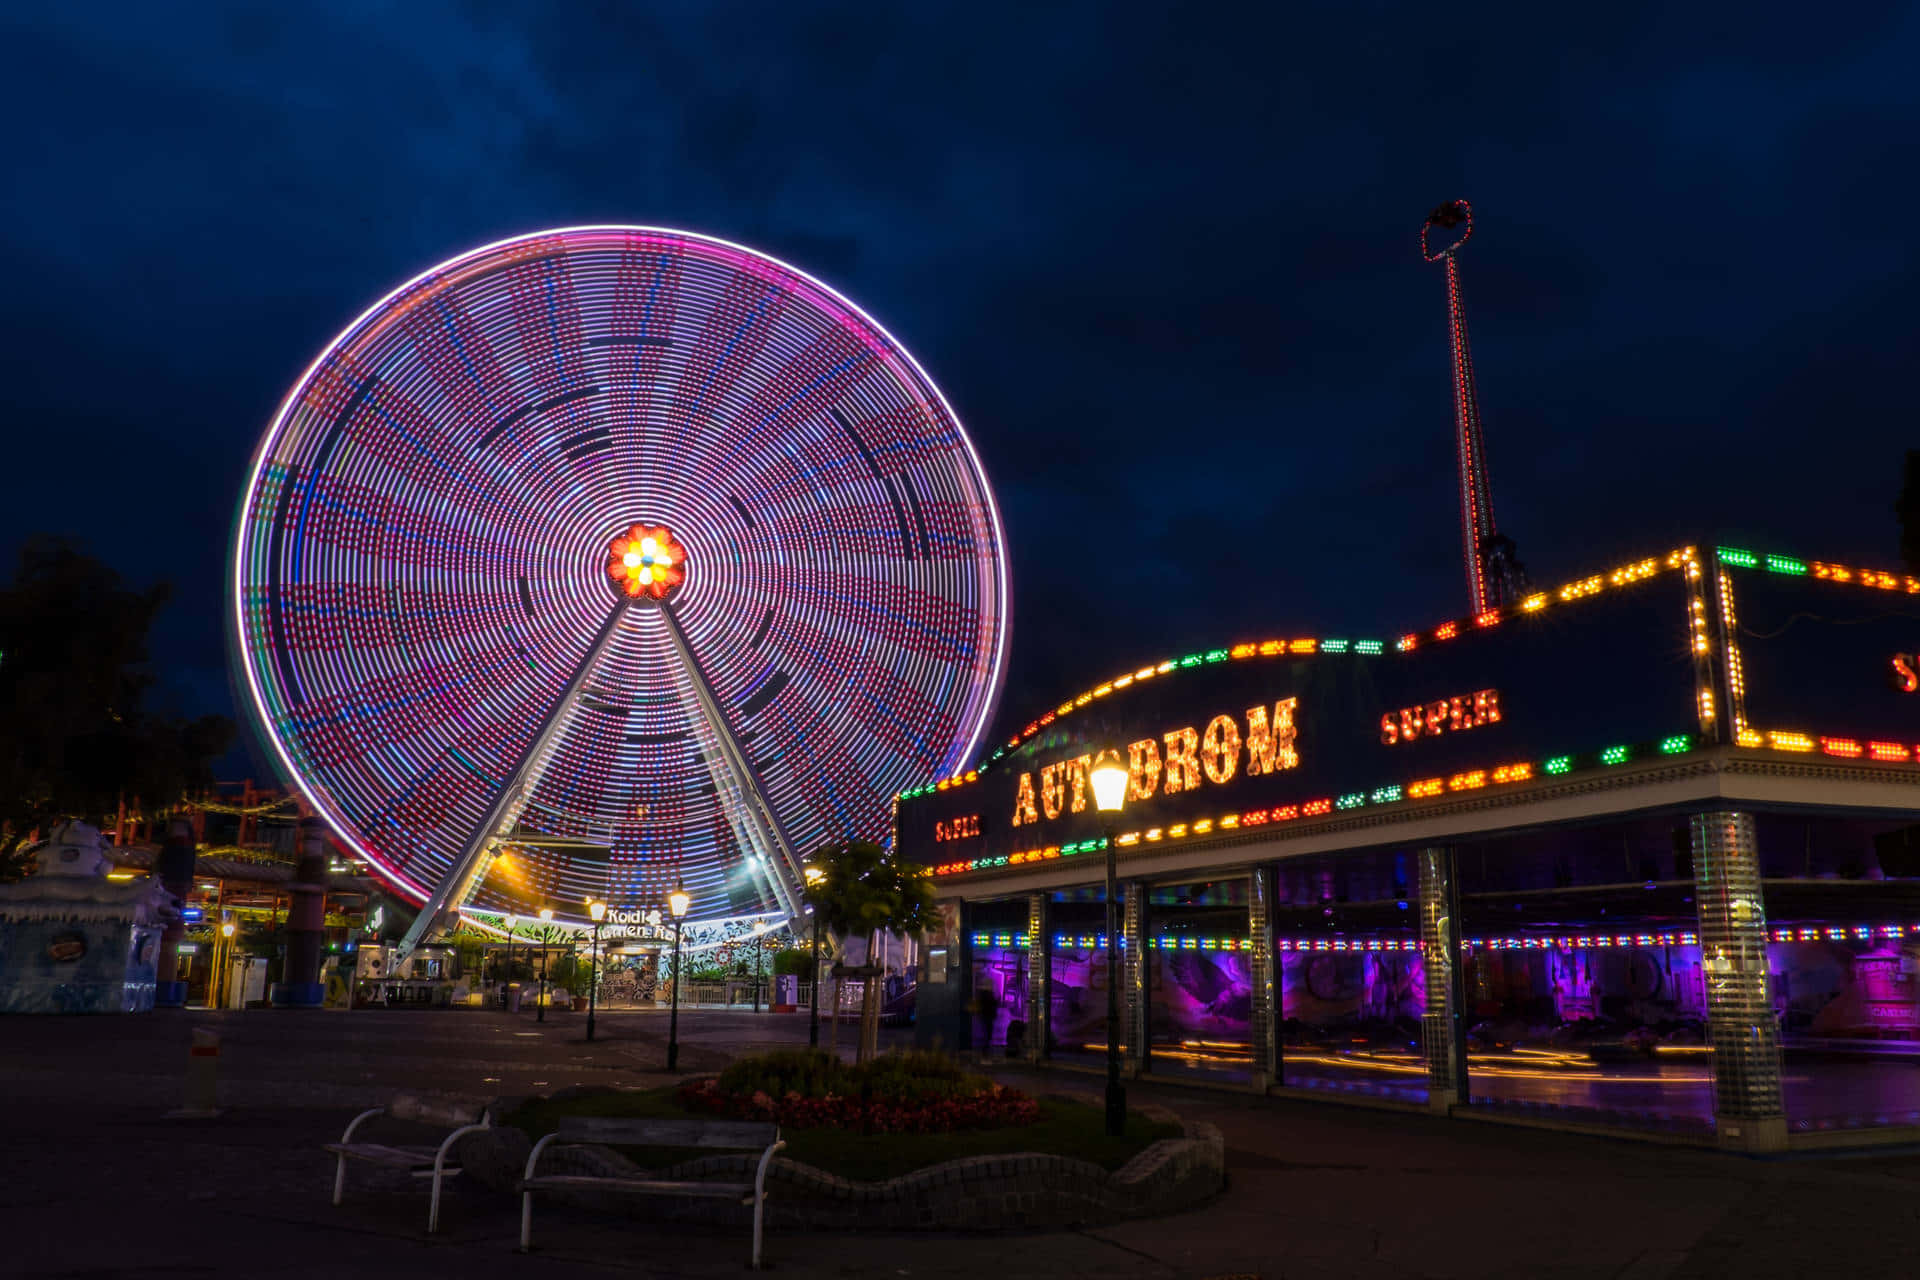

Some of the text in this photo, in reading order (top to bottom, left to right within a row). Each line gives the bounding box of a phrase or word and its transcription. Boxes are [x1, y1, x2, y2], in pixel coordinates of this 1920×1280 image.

[1892, 652, 1920, 692] S
[1381, 688, 1500, 744] SUPER
[1012, 697, 1299, 827] AUTDROM
[608, 909, 646, 923] Koidl
